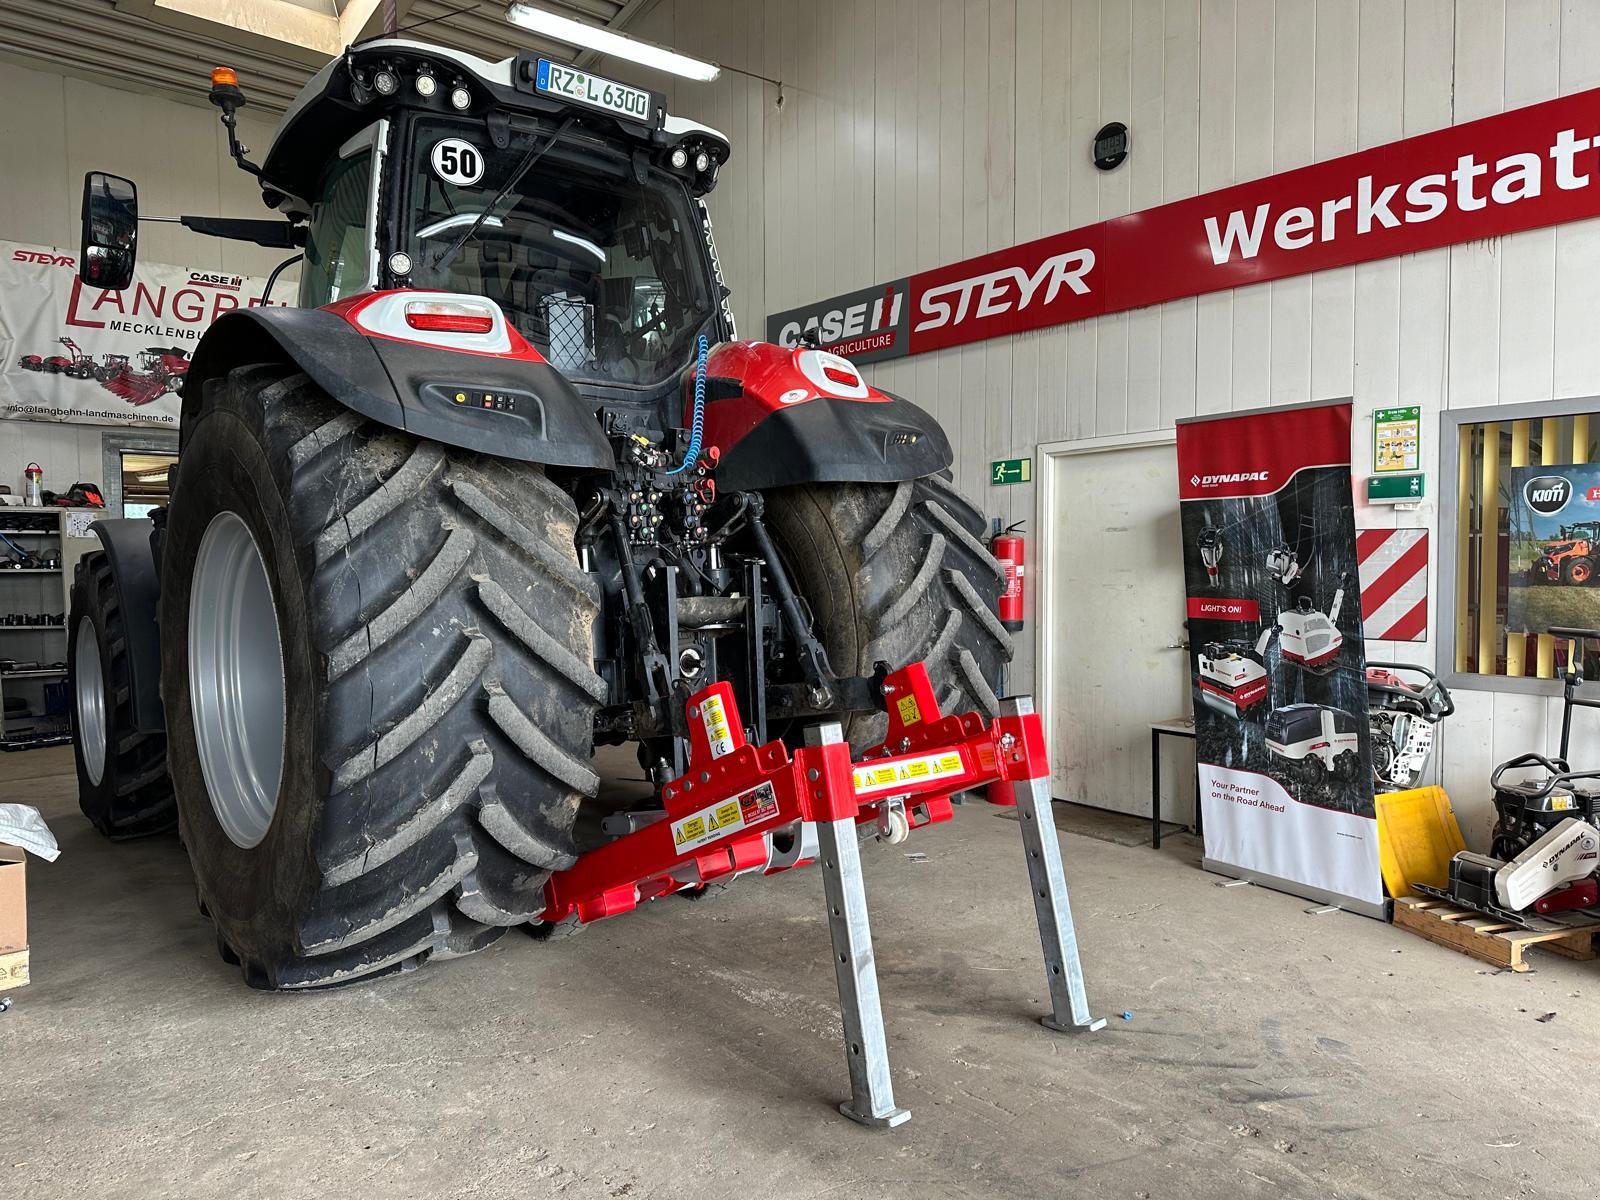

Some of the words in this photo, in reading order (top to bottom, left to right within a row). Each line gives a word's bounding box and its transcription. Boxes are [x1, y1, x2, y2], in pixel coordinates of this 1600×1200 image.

[550, 67, 575, 94] RZ
[587, 78, 598, 102] L
[603, 84, 646, 116] 6300
[441, 146, 476, 179] 50
[12, 250, 76, 268] STEYR
[190, 272, 229, 285] CASE
[915, 247, 1096, 333] STEYR
[779, 303, 868, 348] CASE
[827, 334, 891, 356] AGRICULTURE
[7, 404, 174, 423] info@langbehn-landmaschinen.de
[1202, 471, 1269, 484] DYNAPAC
[1532, 488, 1564, 502] KIOTI
[1201, 604, 1227, 613] LIGHT'S
[1227, 605, 1242, 613] ON!
[1211, 780, 1228, 790] Your
[1230, 784, 1259, 796] Partner
[1212, 791, 1222, 799] on
[1223, 792, 1235, 802] the
[1236, 796, 1258, 807] Road
[1260, 800, 1285, 813] Ahead
[1548, 831, 1586, 864] DYNAPAC
